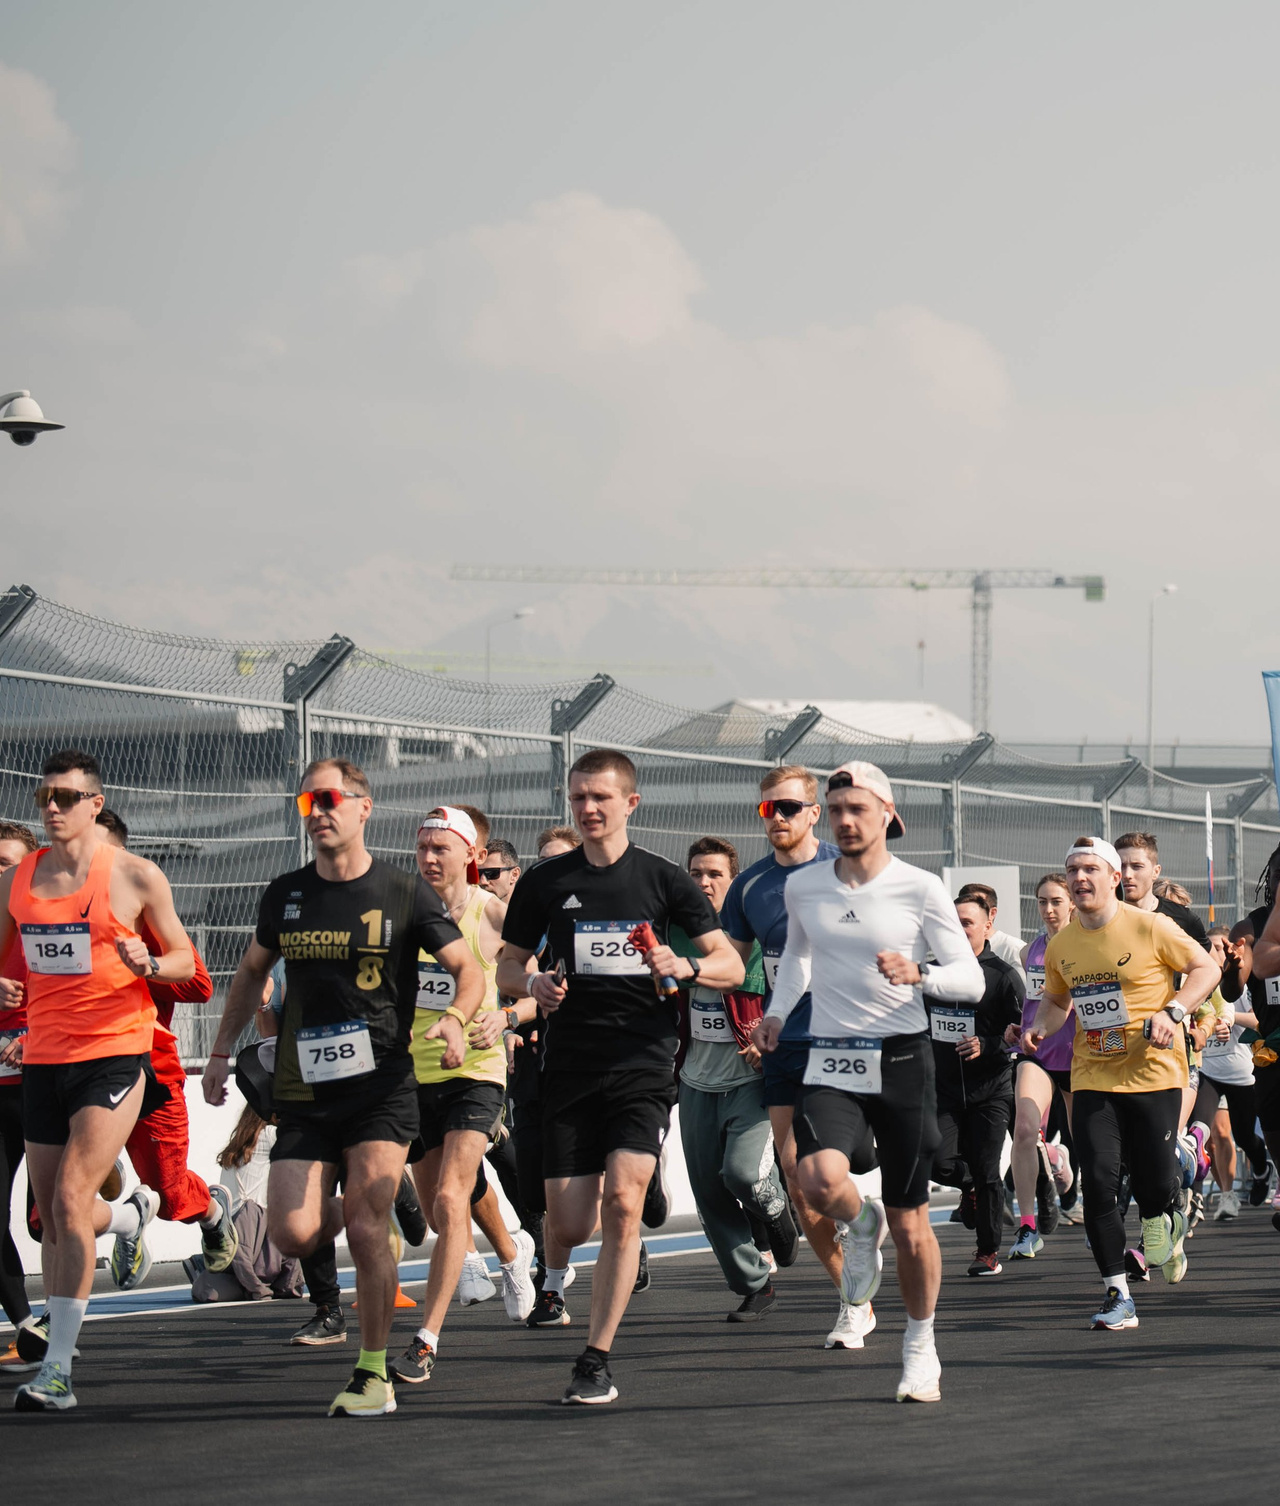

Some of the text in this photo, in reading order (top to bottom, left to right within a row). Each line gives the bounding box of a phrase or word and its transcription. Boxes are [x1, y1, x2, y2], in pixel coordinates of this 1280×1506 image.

[360, 909, 383, 946] 1
[280, 931, 351, 947] MOSCOW
[36, 943, 74, 958] 184
[590, 942, 637, 957] 526
[1071, 972, 1118, 986] МАРАФОН
[1078, 998, 1119, 1017] 1890
[936, 1020, 967, 1033] 1182
[309, 1043, 355, 1064] 758
[822, 1058, 867, 1074] 326
